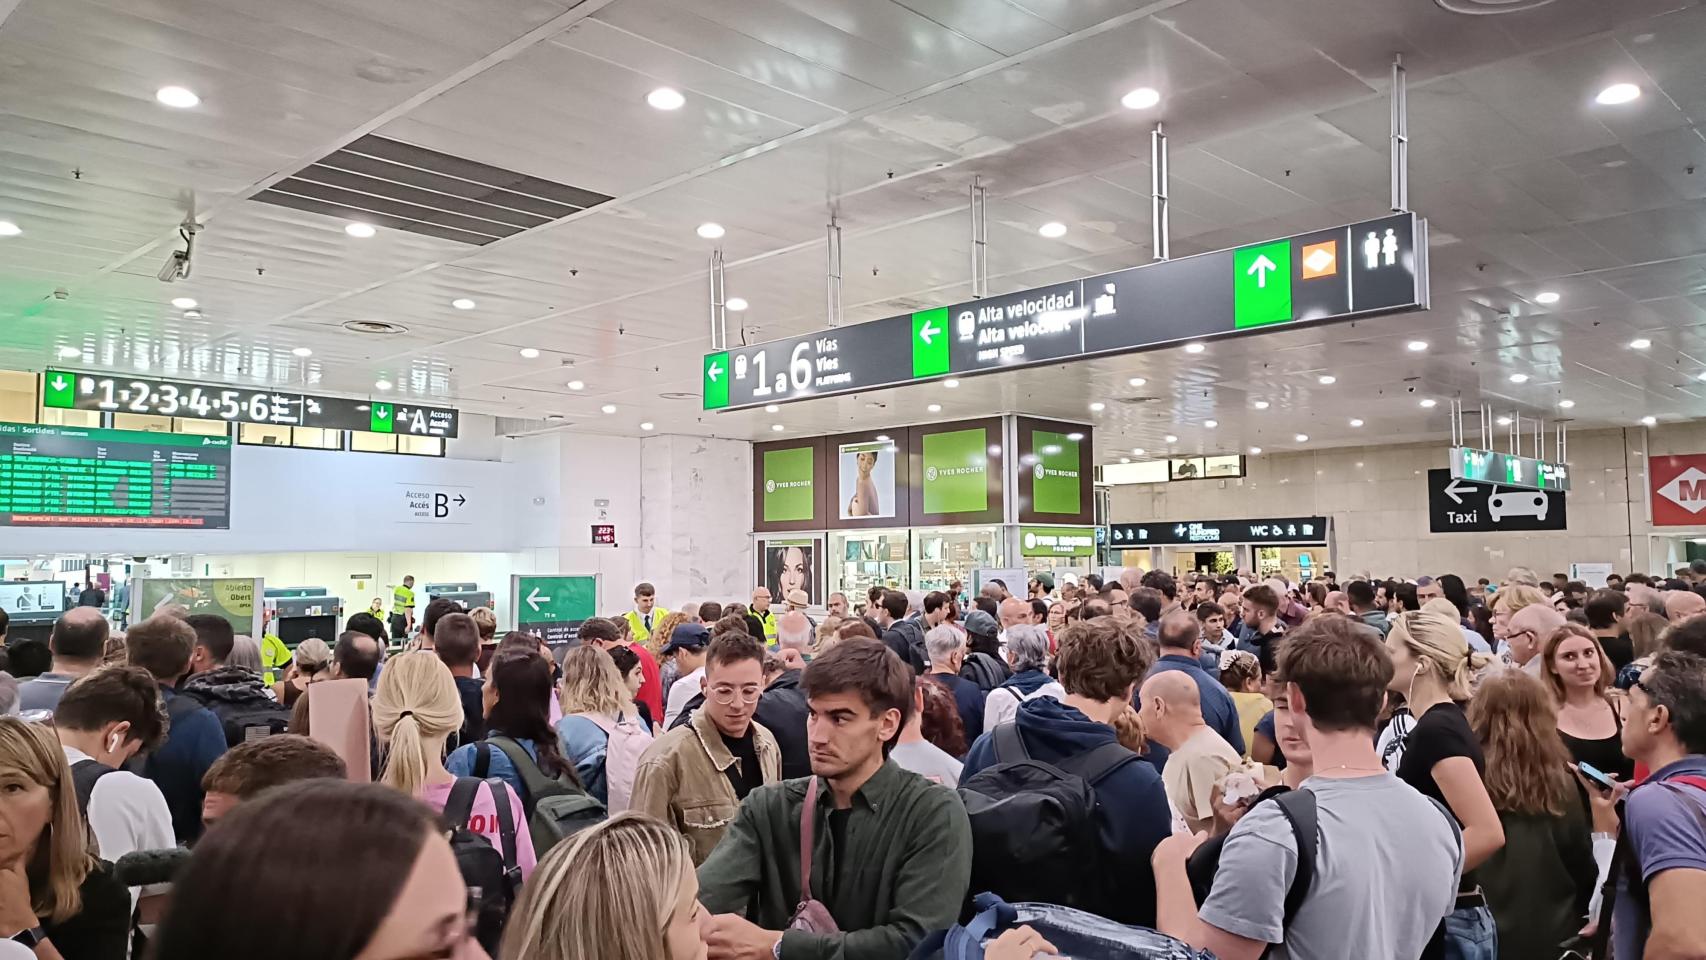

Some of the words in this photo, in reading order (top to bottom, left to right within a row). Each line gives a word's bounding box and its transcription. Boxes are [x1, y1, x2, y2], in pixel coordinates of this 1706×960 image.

[978, 306, 1004, 324] Alta
[1007, 290, 1074, 319] velocidad
[978, 327, 1006, 345] Alta
[815, 337, 838, 354] Vías
[752, 350, 772, 396] 1
[775, 372, 787, 393] a
[790, 341, 812, 391] 6
[430, 410, 453, 419] Acceso
[410, 409, 428, 434] A
[22, 426, 55, 435] Sortides
[939, 468, 955, 476] YVES
[957, 466, 984, 474] ROCHER
[406, 490, 430, 499] Acceso
[410, 501, 430, 509] Accés
[434, 492, 449, 518] B
[1447, 511, 1478, 524] Taxi
[1250, 525, 1269, 536] WC
